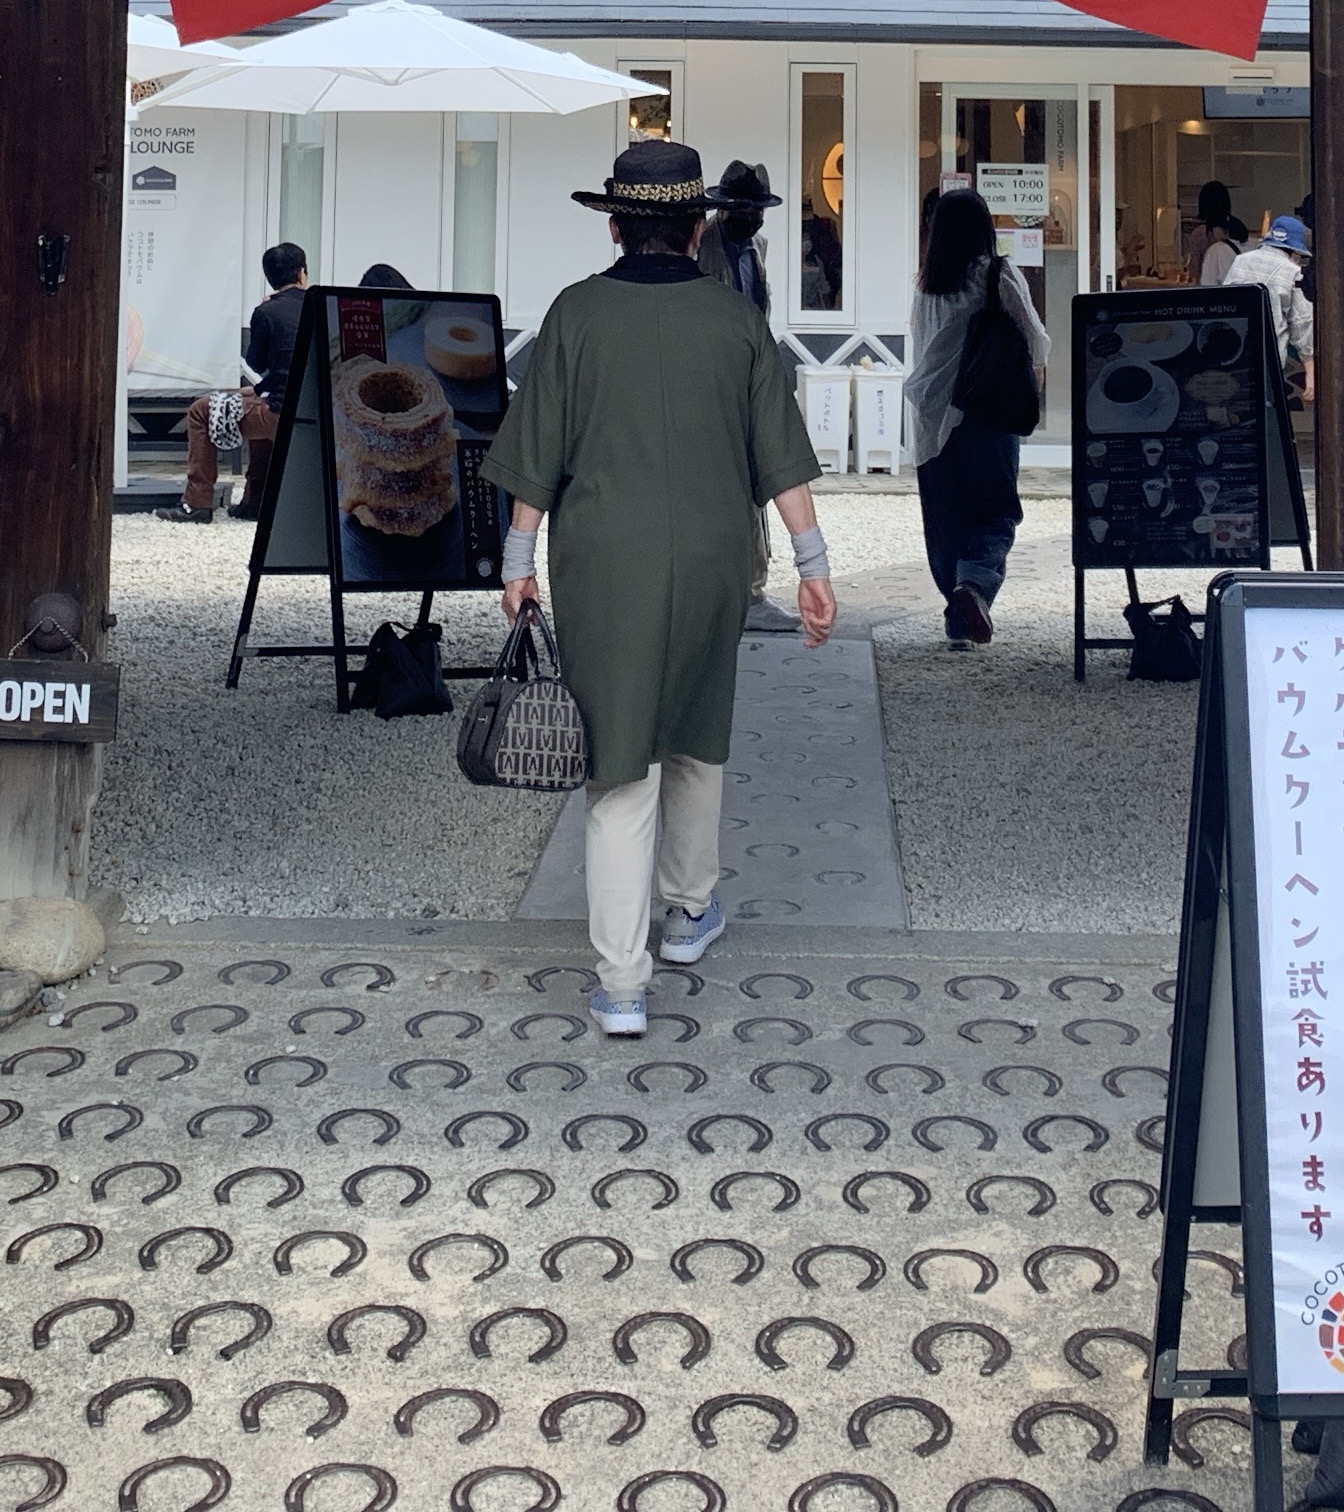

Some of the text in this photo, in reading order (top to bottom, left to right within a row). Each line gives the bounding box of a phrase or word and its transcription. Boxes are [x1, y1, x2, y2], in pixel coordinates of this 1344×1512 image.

[166, 128, 196, 137] FARM
[130, 141, 196, 154] LOUNGE
[983, 180, 1044, 189] OPEN 10:00
[1013, 194, 1044, 203] 17:00
[1154, 307, 1174, 316] HOT
[1177, 306, 1205, 315] DRINK
[1209, 305, 1237, 313] MENU
[1272, 643, 1332, 1242] バウムクーヘン試食あります
